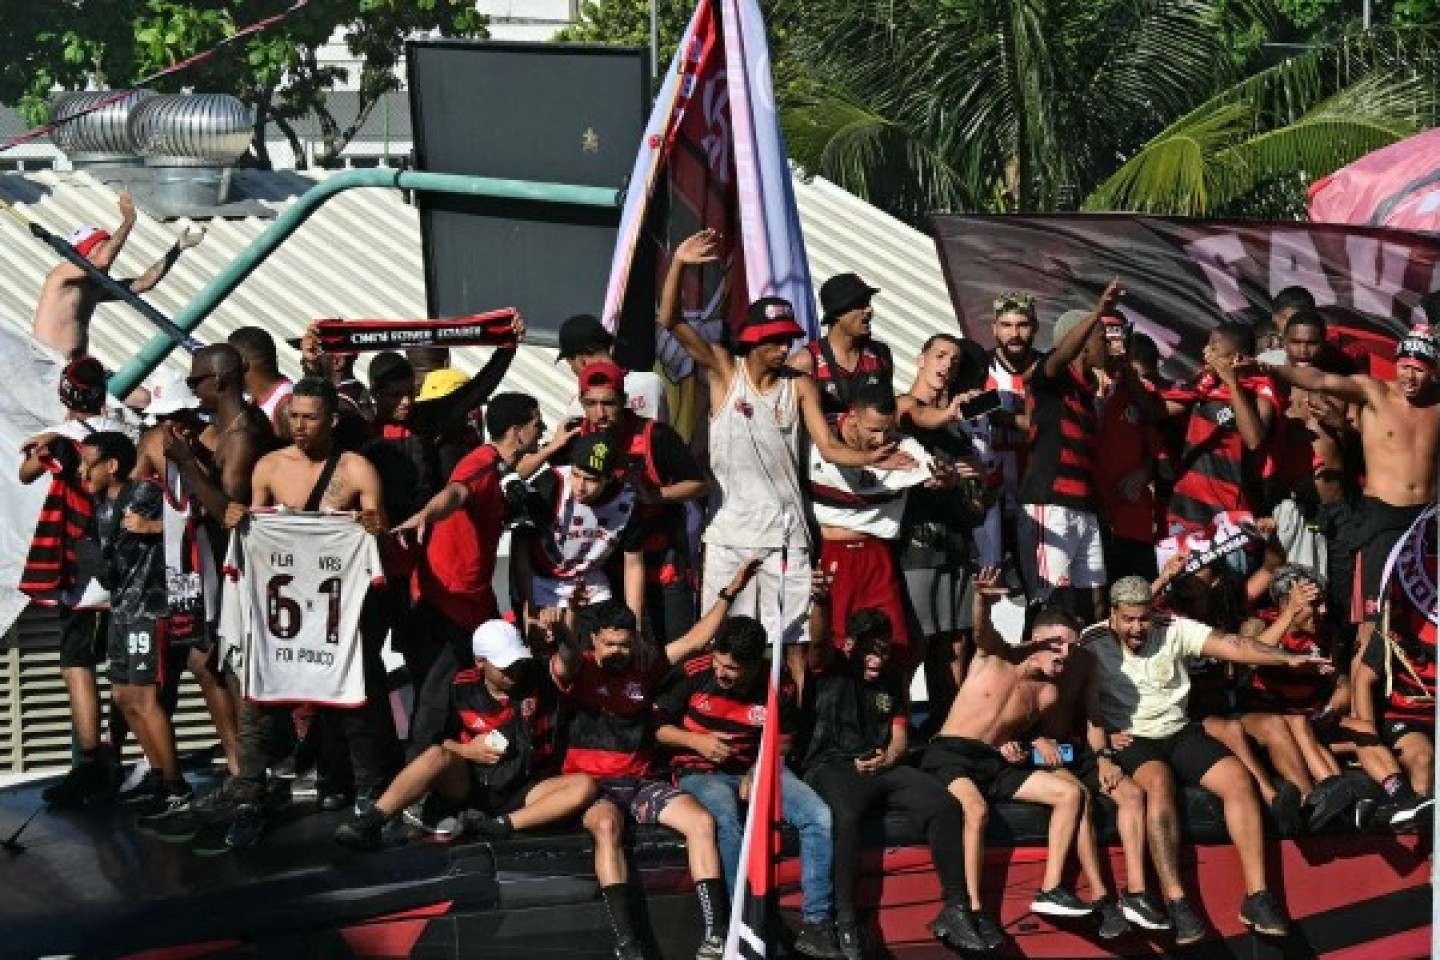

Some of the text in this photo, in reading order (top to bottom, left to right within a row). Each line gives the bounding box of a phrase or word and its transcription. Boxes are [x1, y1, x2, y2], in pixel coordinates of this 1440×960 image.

[270, 551, 294, 567] FLA
[266, 573, 303, 640] 6
[316, 576, 342, 644] 1
